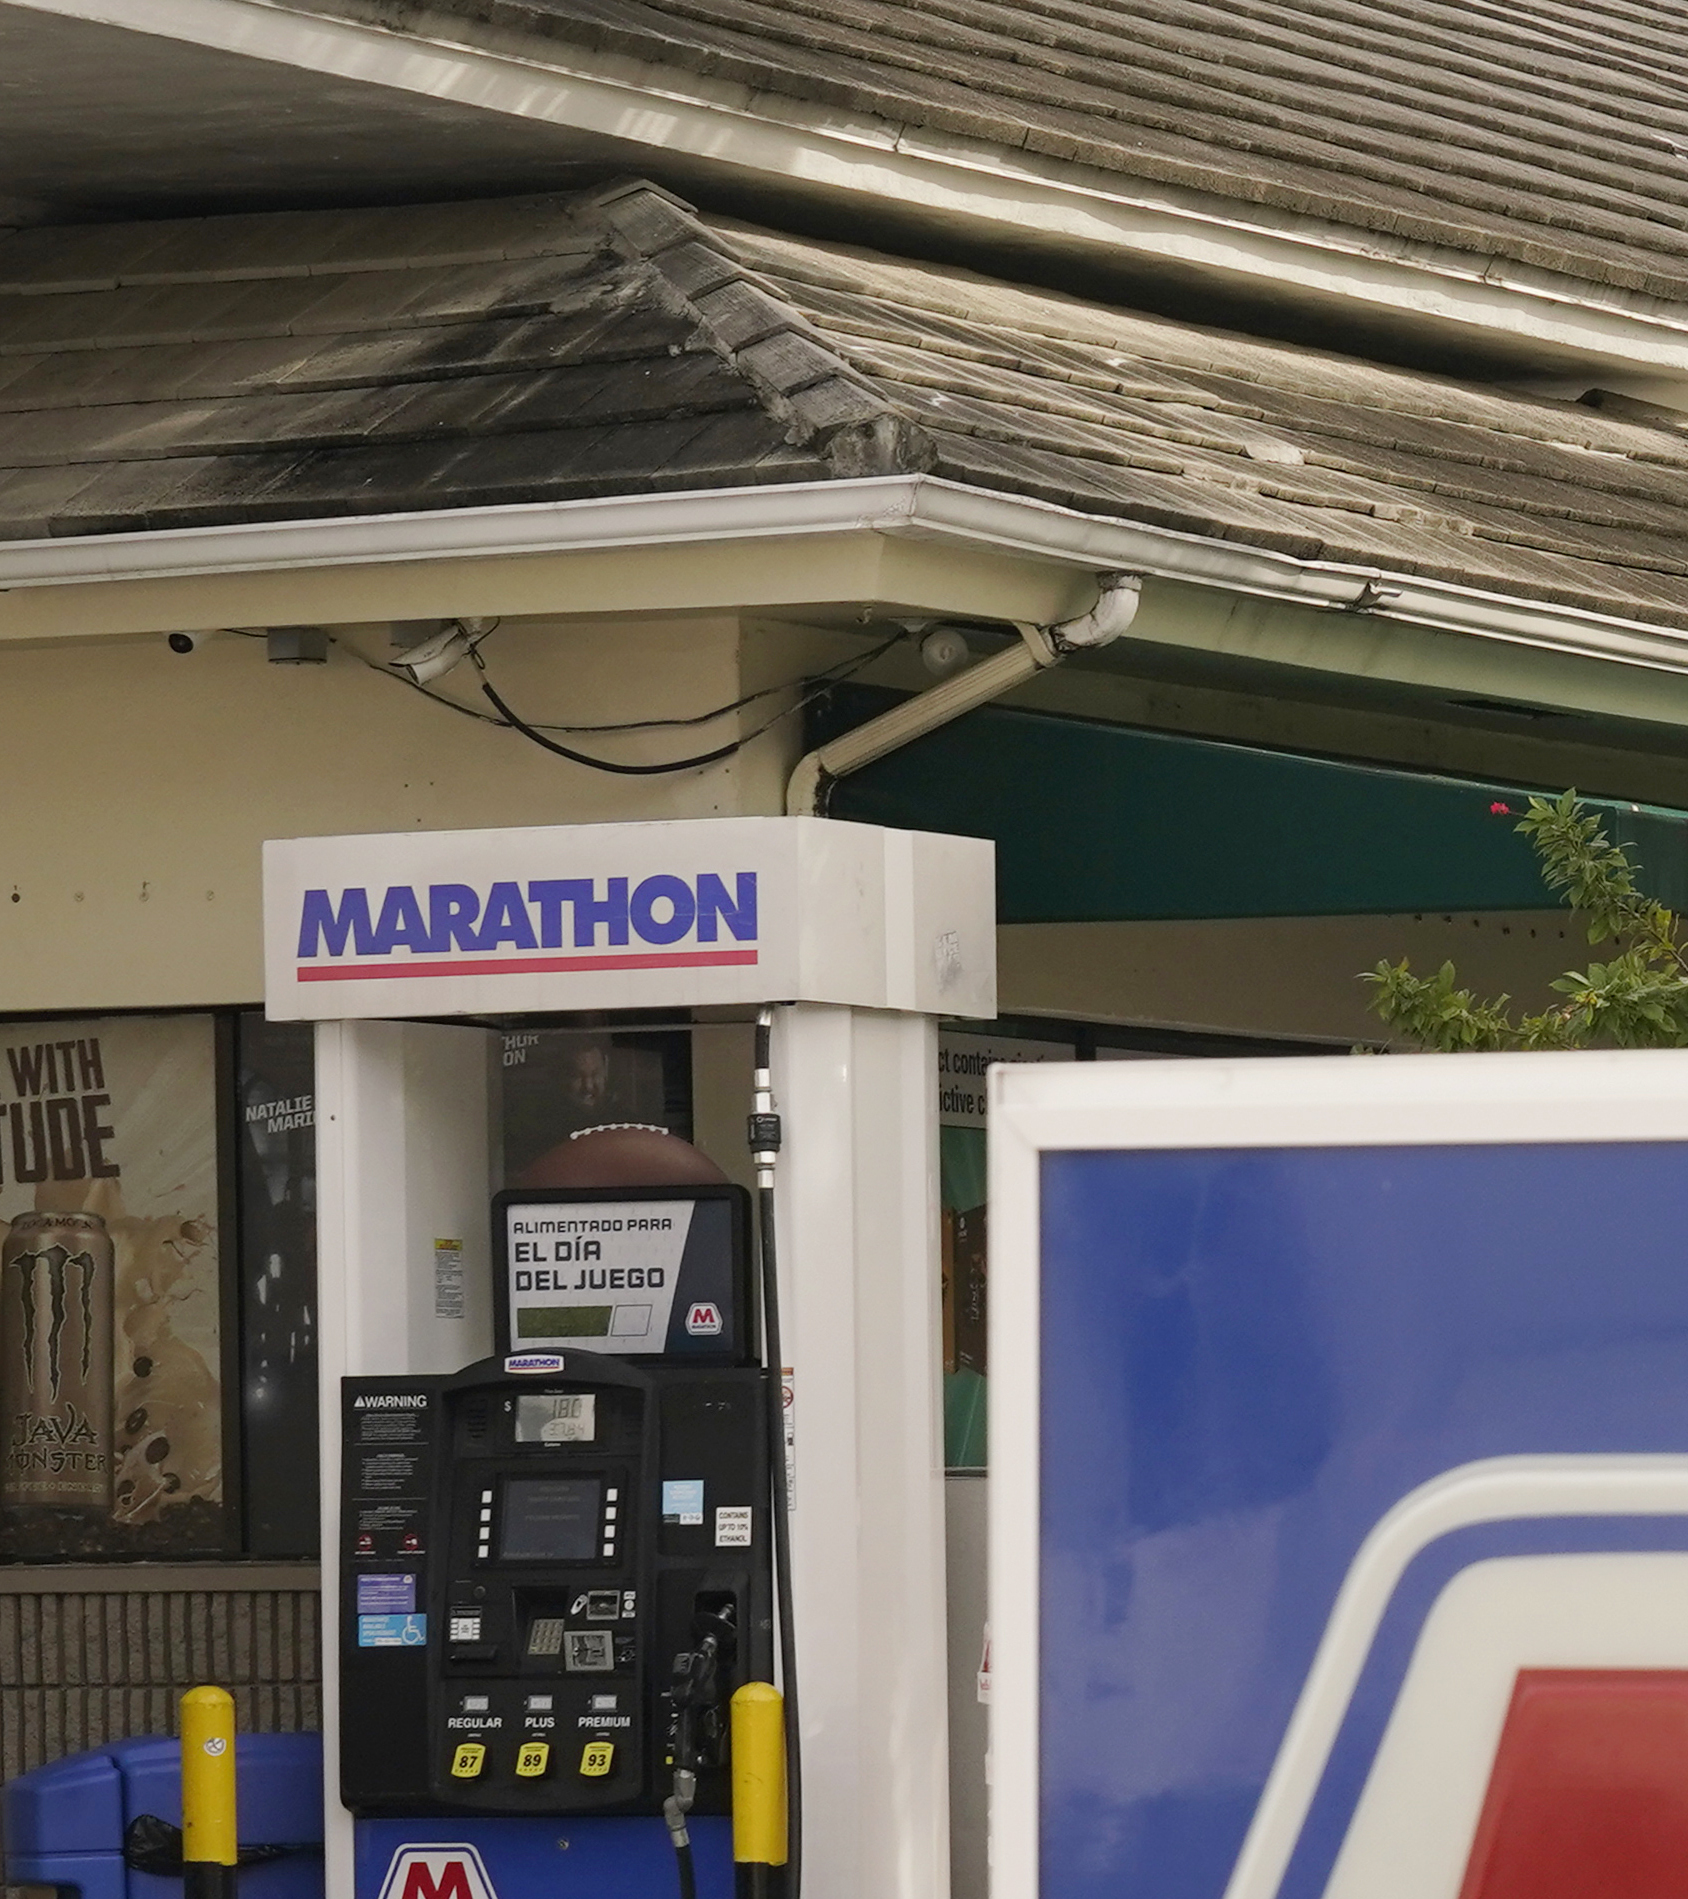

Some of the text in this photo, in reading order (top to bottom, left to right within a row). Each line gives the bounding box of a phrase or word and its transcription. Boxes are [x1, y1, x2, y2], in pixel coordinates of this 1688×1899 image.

[297, 872, 757, 958] MARATHON
[6, 1038, 105, 1097] WITH
[246, 1094, 312, 1122] NATALIE
[268, 1111, 315, 1133] MARI
[0, 1094, 121, 1185] UDE
[513, 1218, 672, 1234] ALIMENTADO PARA
[515, 1236, 601, 1262] EL DÍA
[516, 1267, 665, 1292] DEL JUEGO
[508, 1357, 561, 1367] MARATHON
[364, 1395, 427, 1408] WARNING
[12, 1402, 99, 1447] JAVA
[448, 1716, 631, 1728] REGULAR PLUS PREMIUM
[459, 1755, 478, 1768] 87
[523, 1754, 542, 1767] 89
[587, 1754, 606, 1767] 93
